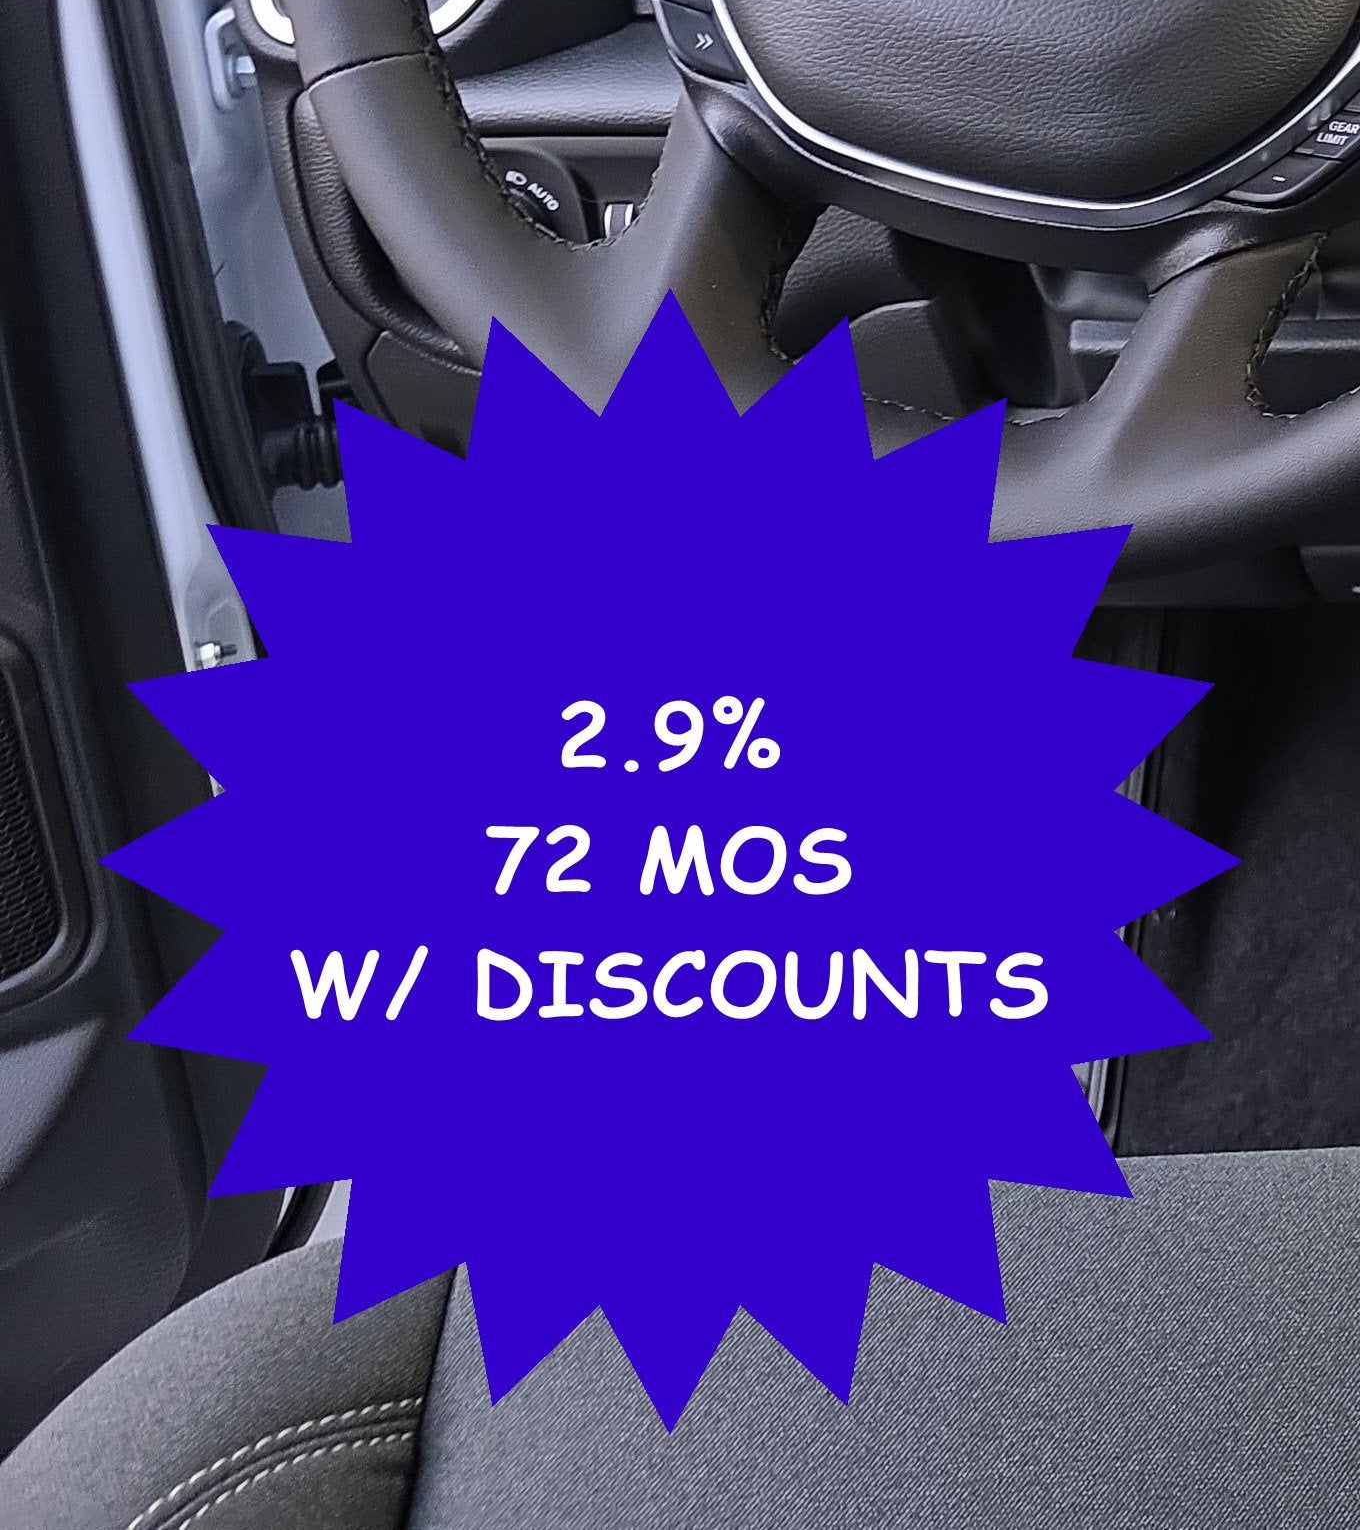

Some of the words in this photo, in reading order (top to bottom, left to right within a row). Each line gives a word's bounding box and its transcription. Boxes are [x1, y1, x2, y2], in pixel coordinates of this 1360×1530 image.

[1328, 120, 1360, 135] GEAR
[1316, 131, 1350, 146] LIMIT
[529, 182, 560, 211] AUTO
